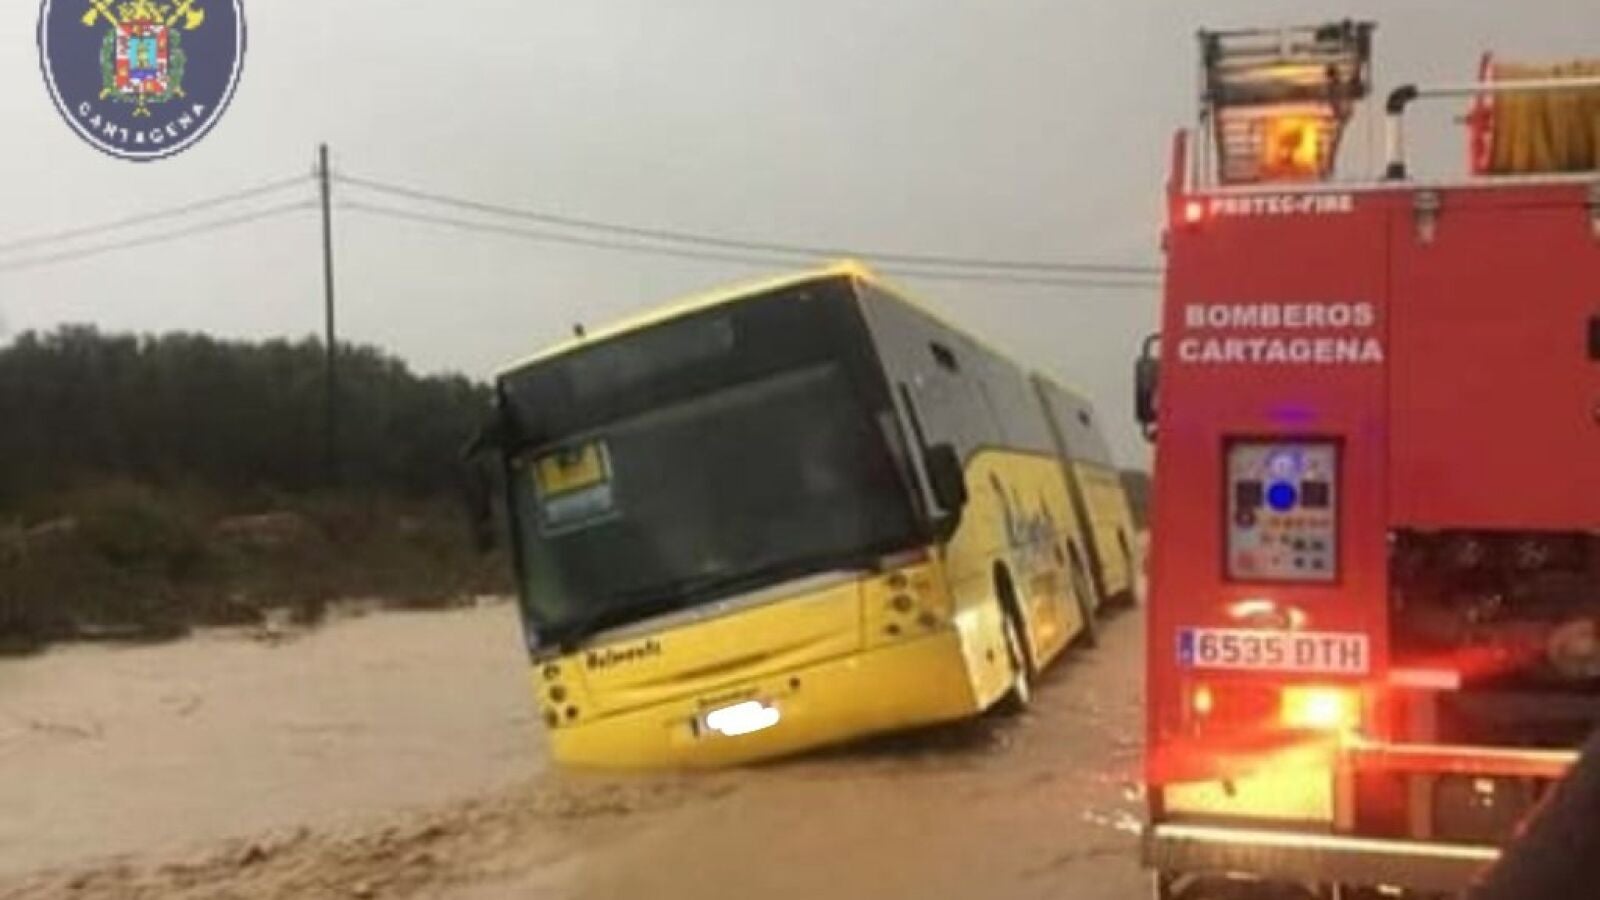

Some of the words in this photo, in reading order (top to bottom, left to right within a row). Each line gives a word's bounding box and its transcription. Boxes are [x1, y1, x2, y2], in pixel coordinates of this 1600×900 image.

[1210, 194, 1354, 216] PROTEC-FIRE
[1185, 303, 1375, 328] BOMBEROS
[1178, 337, 1384, 364] CARTAGENA
[1200, 633, 1284, 666] 6535
[1294, 637, 1362, 668] DTH
